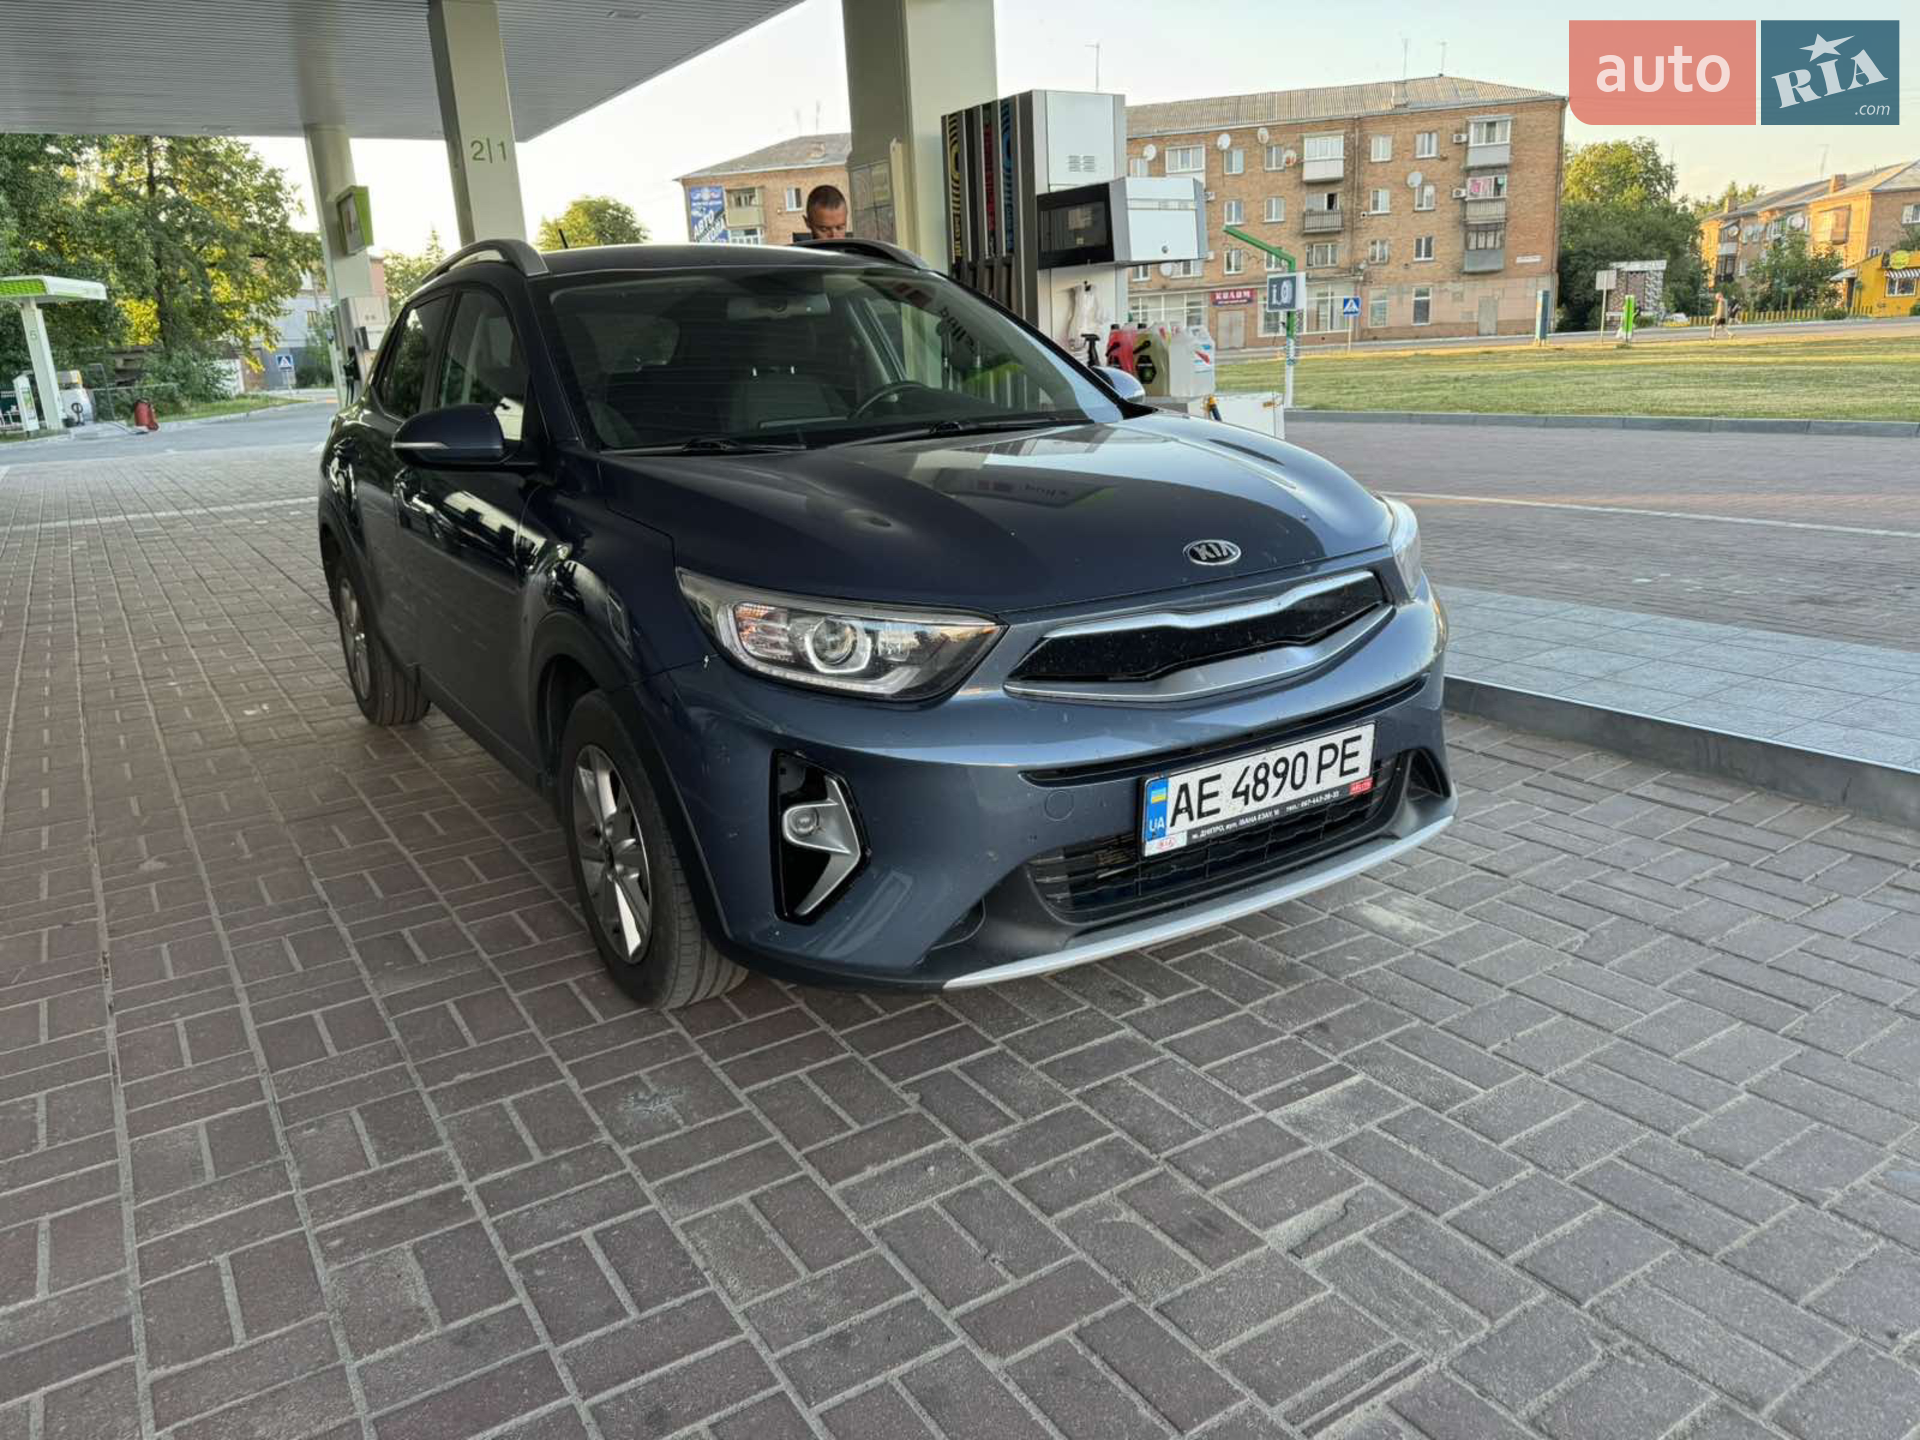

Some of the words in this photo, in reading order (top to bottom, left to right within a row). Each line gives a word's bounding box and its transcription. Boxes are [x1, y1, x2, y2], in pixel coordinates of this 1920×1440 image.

[1190, 541, 1238, 562] KIA
[1169, 773, 1222, 828] AE
[1231, 750, 1309, 806] 4890
[1315, 734, 1362, 785] PE
[1149, 816, 1166, 832] UA
